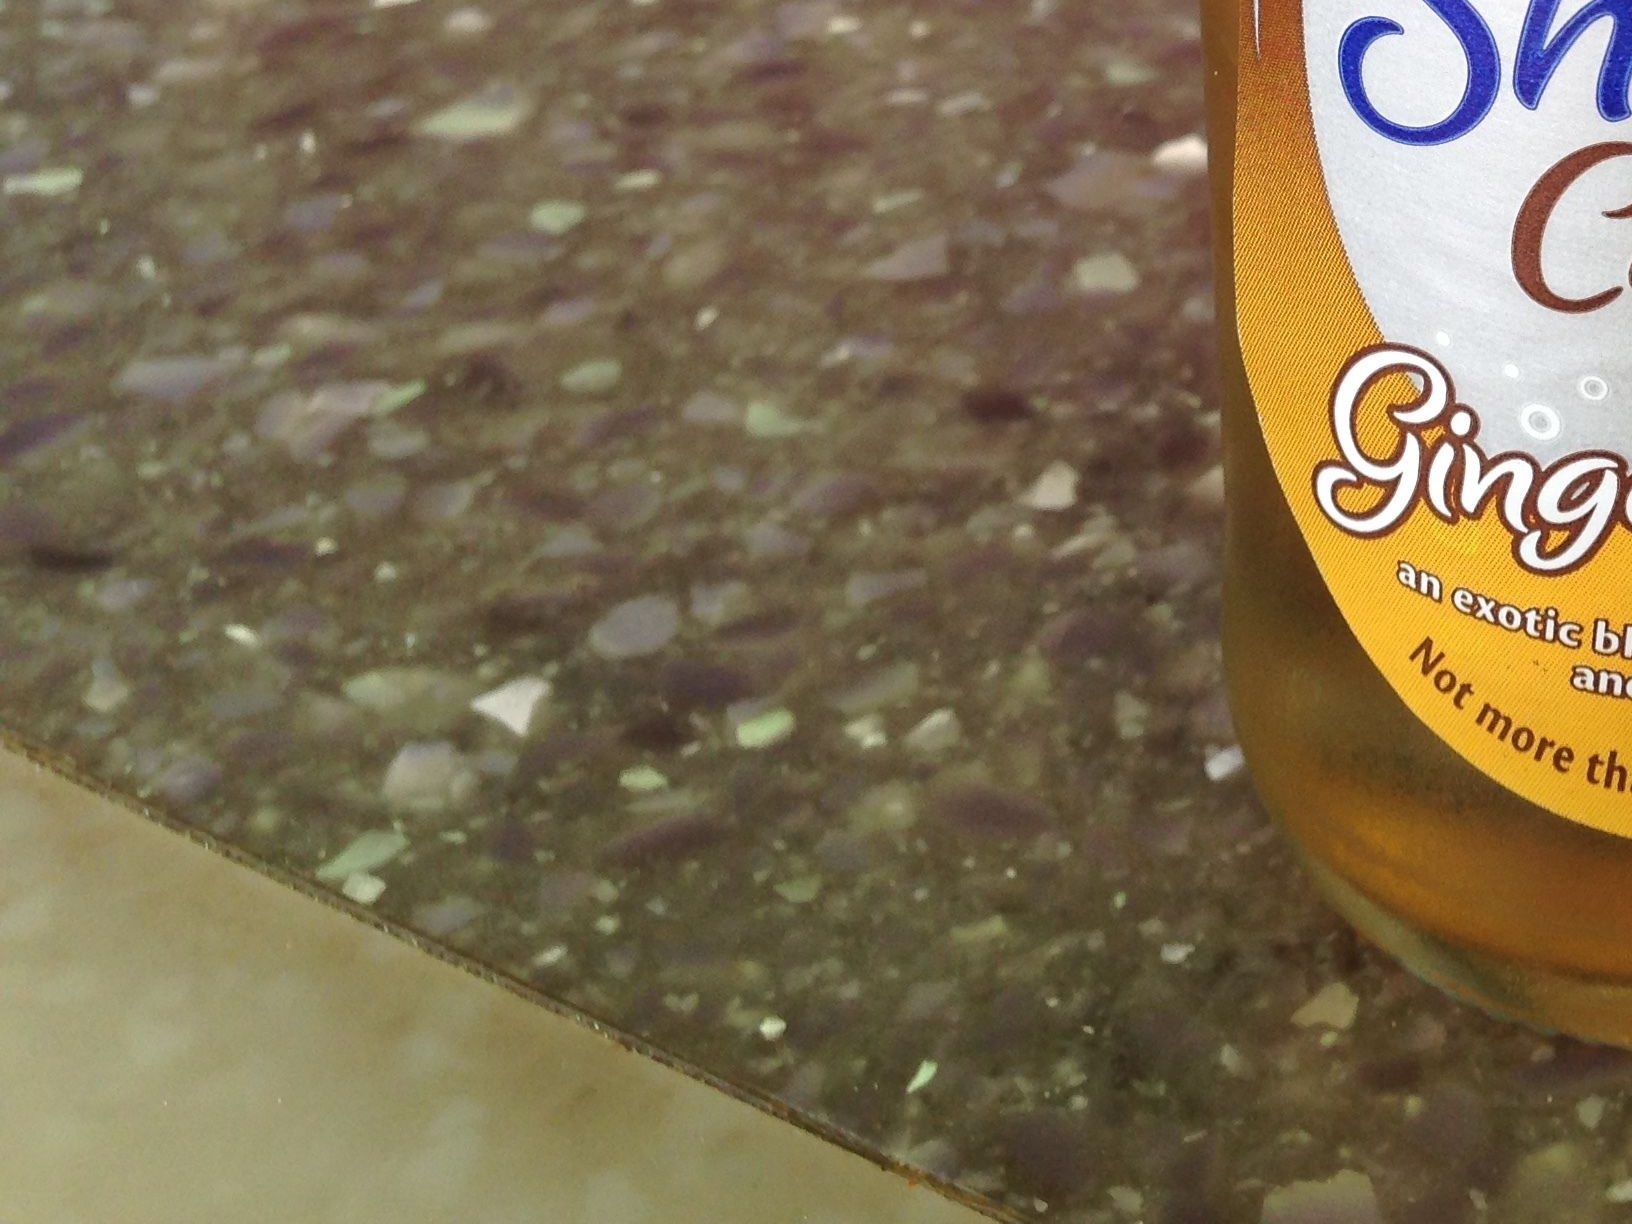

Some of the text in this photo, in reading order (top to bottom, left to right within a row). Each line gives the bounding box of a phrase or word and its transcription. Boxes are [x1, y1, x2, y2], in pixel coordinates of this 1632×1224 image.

[1396, 560, 1442, 603] an
[1451, 587, 1582, 648] exotic
[1409, 636, 1475, 710] Not
[1476, 702, 1575, 774] more
